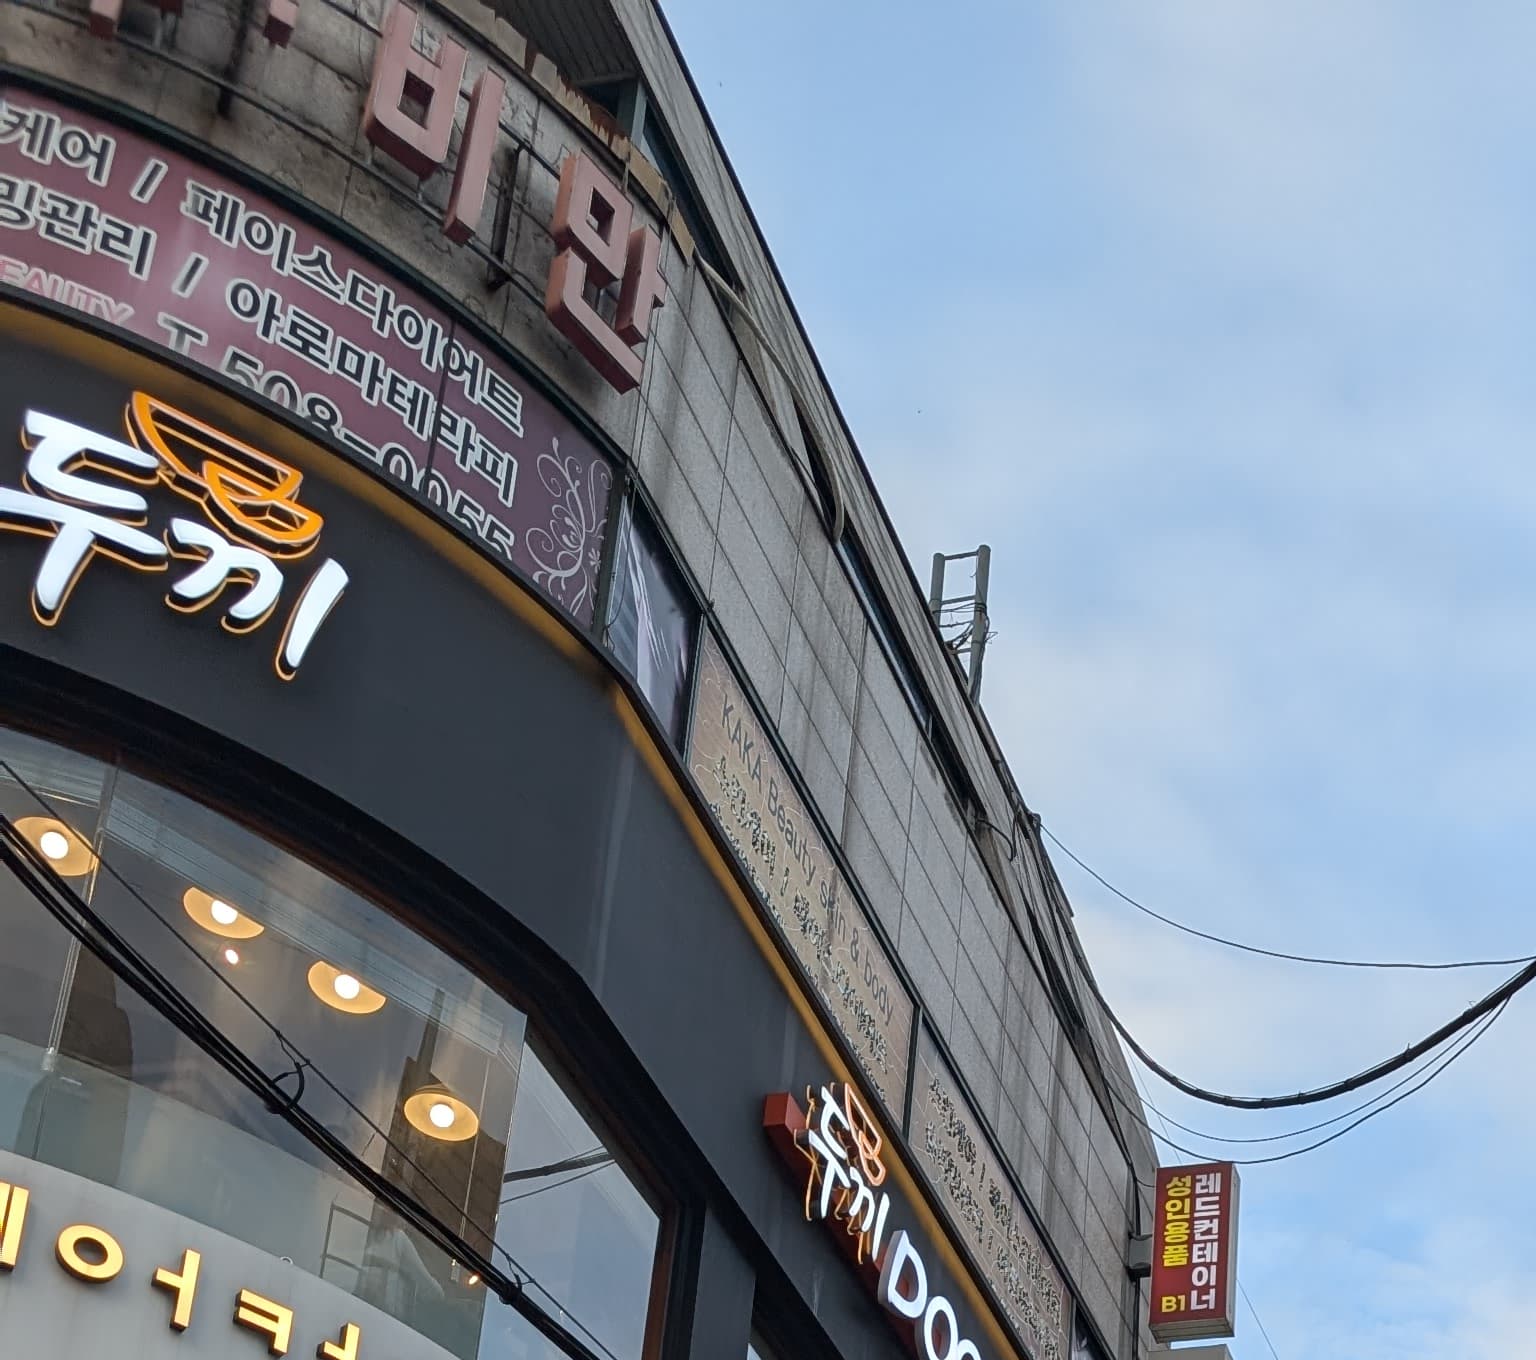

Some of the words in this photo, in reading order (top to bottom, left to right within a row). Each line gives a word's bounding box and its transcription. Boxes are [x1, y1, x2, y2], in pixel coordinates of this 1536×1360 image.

[180, 180, 524, 438] 페이스다이어트
[225, 277, 518, 506] 아로마테라피
[718, 691, 764, 797] KAKA
[765, 783, 818, 888] Beauty
[860, 948, 895, 1028] body
[1161, 1295, 1186, 1313] B1
[1162, 1175, 1192, 1267] 성인용품
[1190, 1173, 1221, 1312] 레드컨테이너
